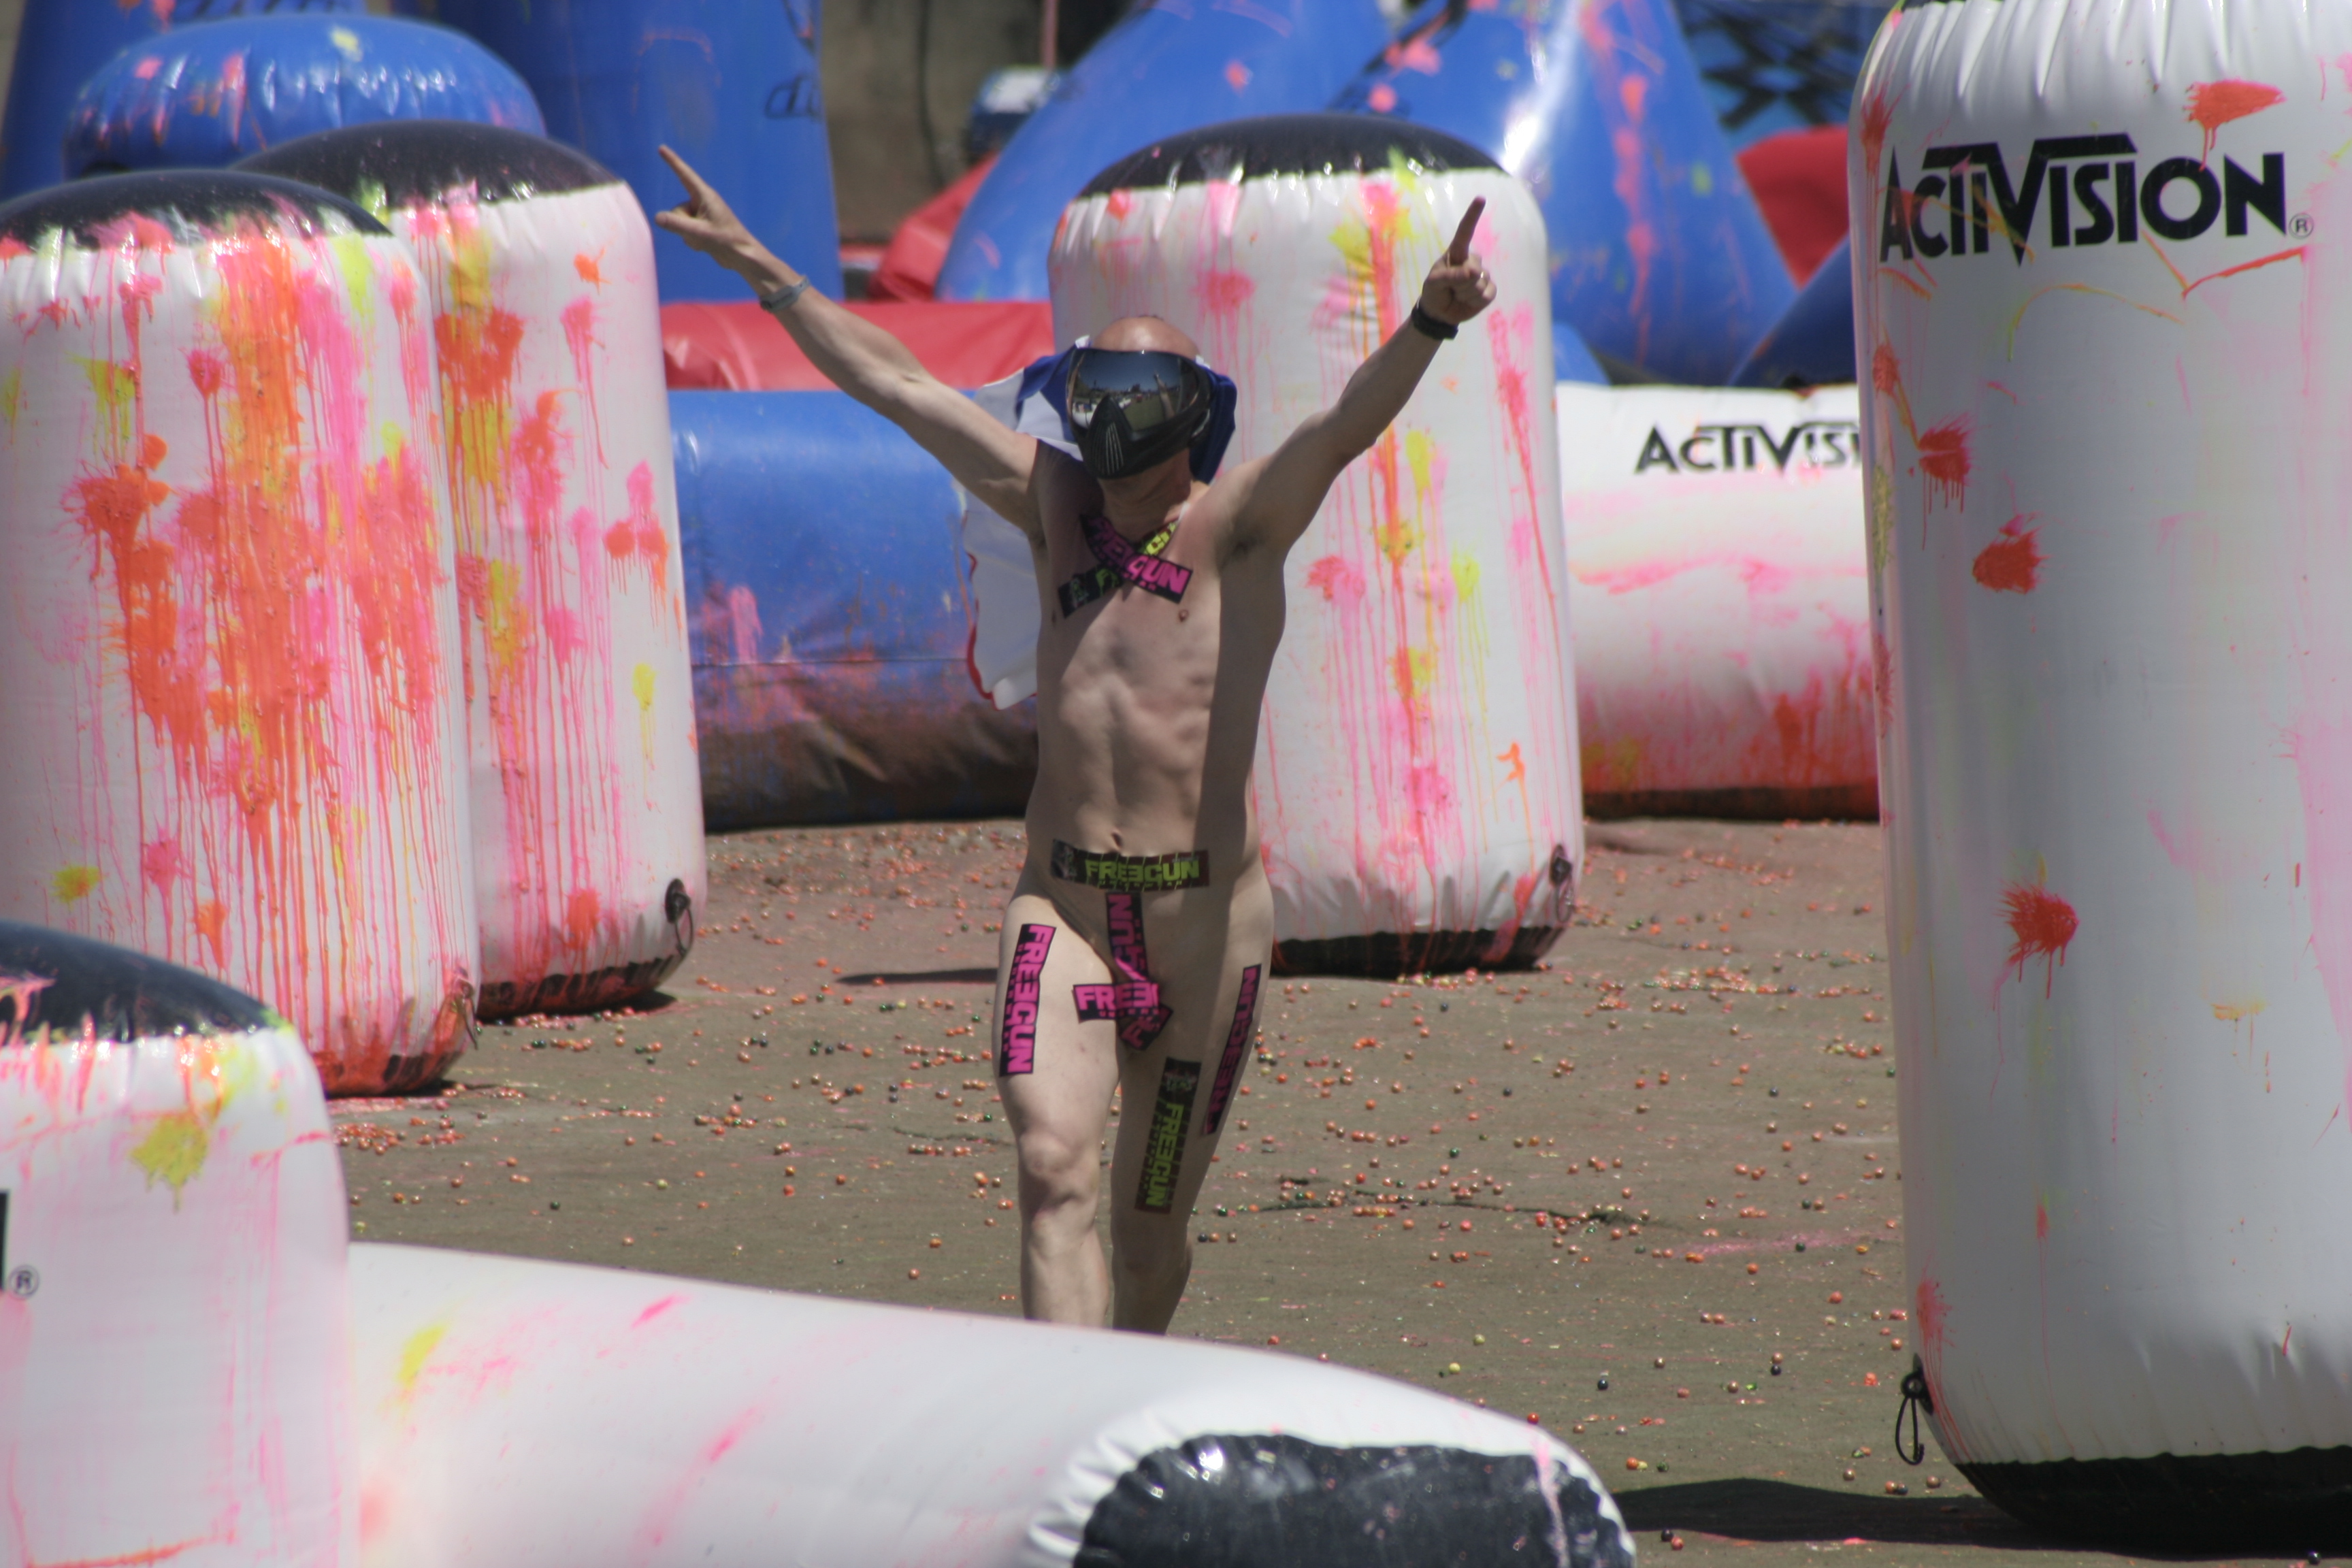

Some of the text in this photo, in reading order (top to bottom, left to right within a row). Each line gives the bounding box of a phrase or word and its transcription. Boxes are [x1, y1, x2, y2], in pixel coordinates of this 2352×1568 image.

[1085, 860, 1199, 885] FREEGUN
[1005, 925, 1055, 1073] FREEGUN
[1145, 1103, 1184, 1206] FREEGUN
